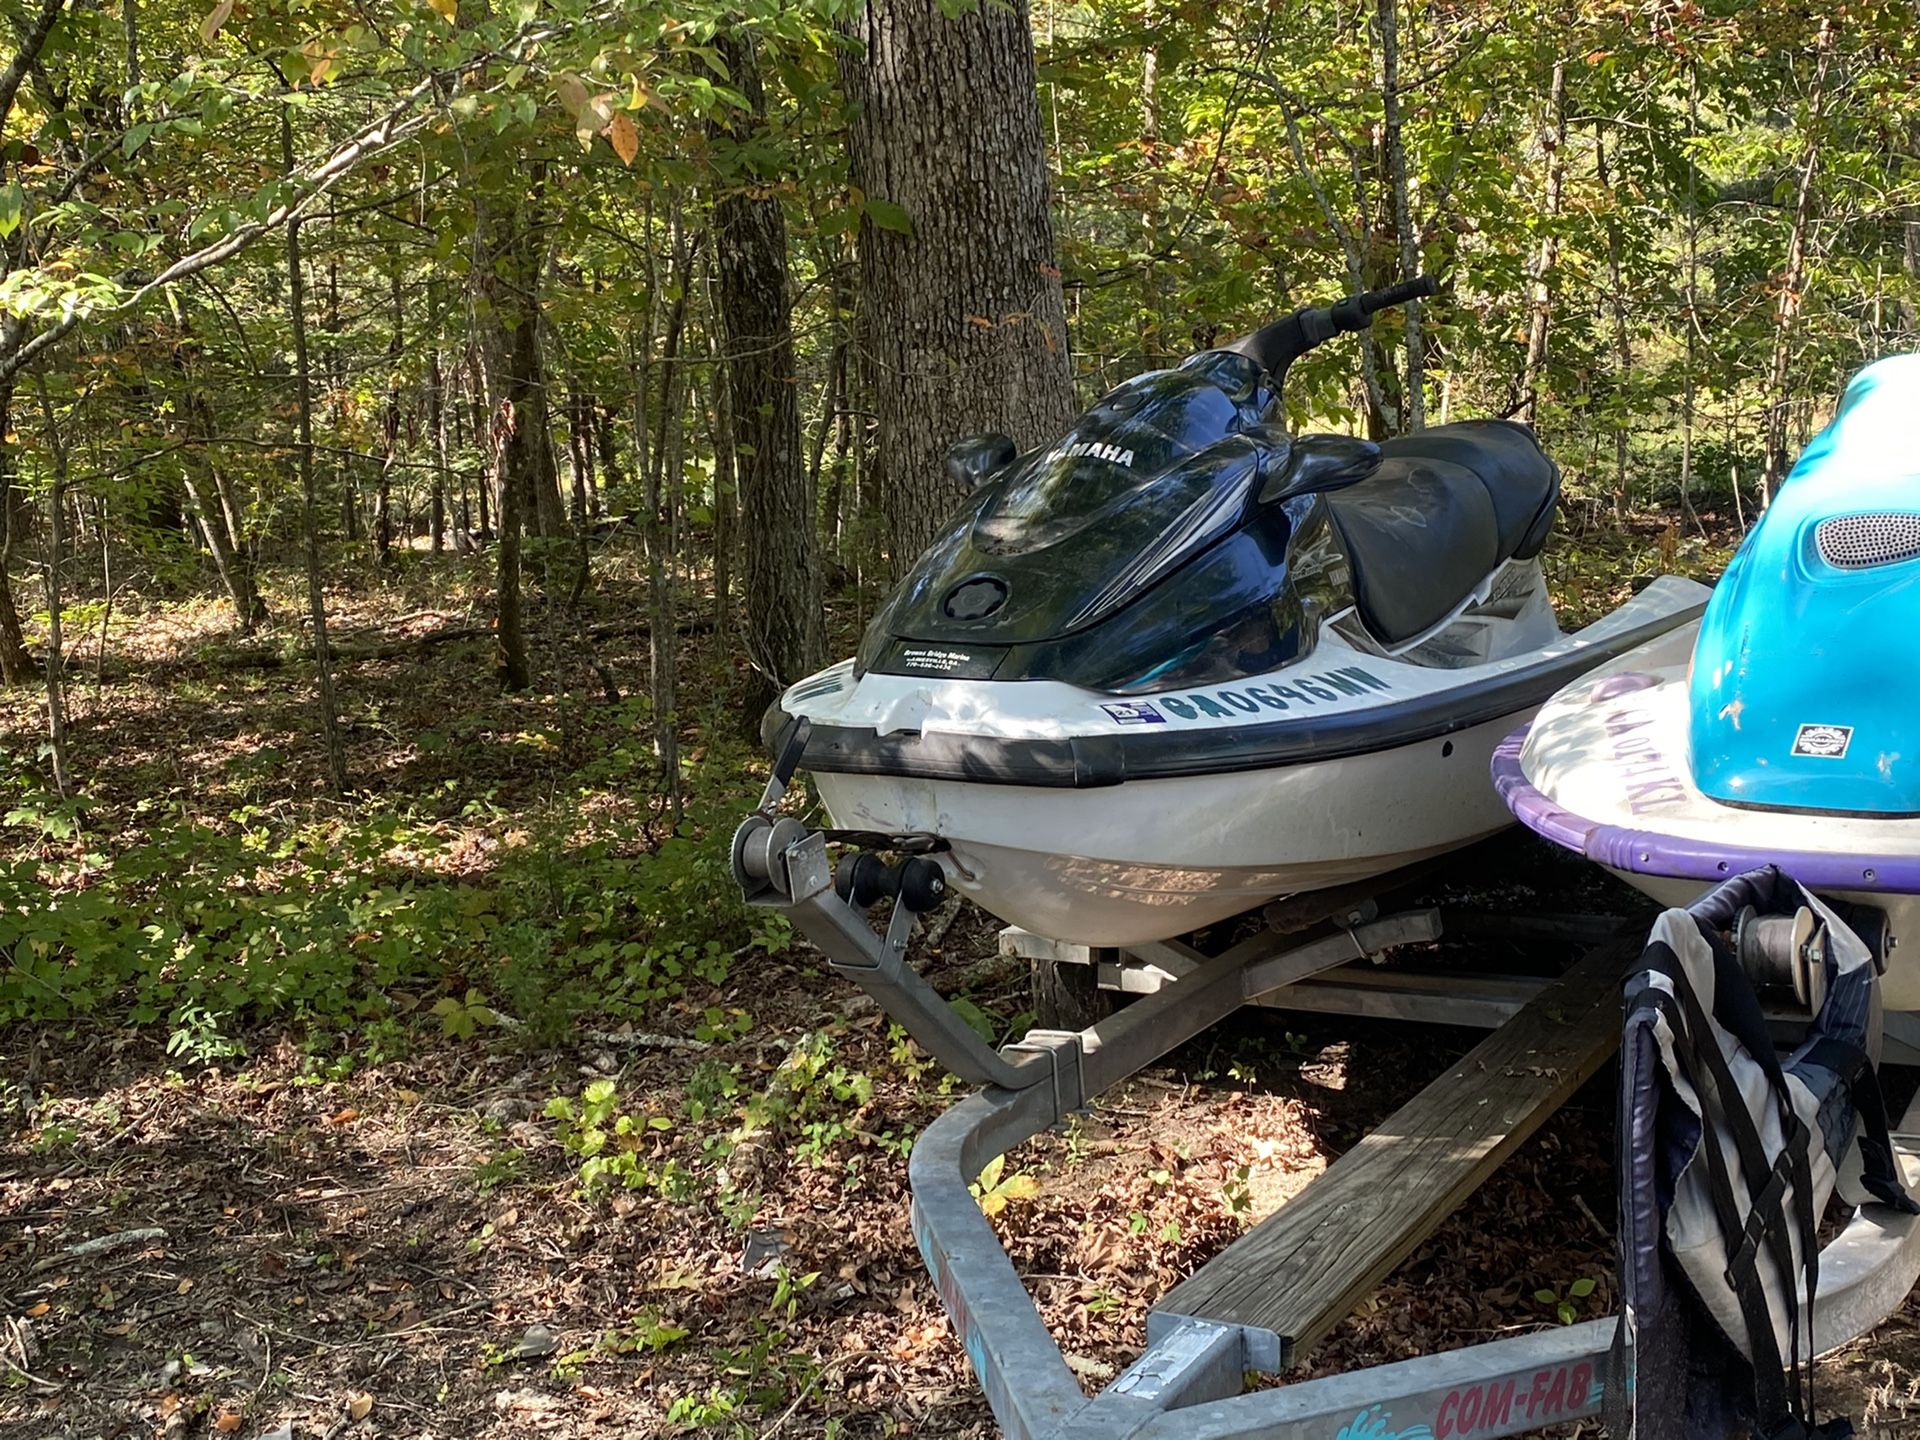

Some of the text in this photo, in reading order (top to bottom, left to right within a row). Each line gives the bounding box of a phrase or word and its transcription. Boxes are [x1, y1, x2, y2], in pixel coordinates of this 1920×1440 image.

[1045, 442, 1134, 468] YAMAHA
[927, 650, 947, 659] Bridge
[947, 652, 971, 661] Marine
[1626, 777, 1688, 816] KL
[1434, 1362, 1593, 1440] COM-FAB
